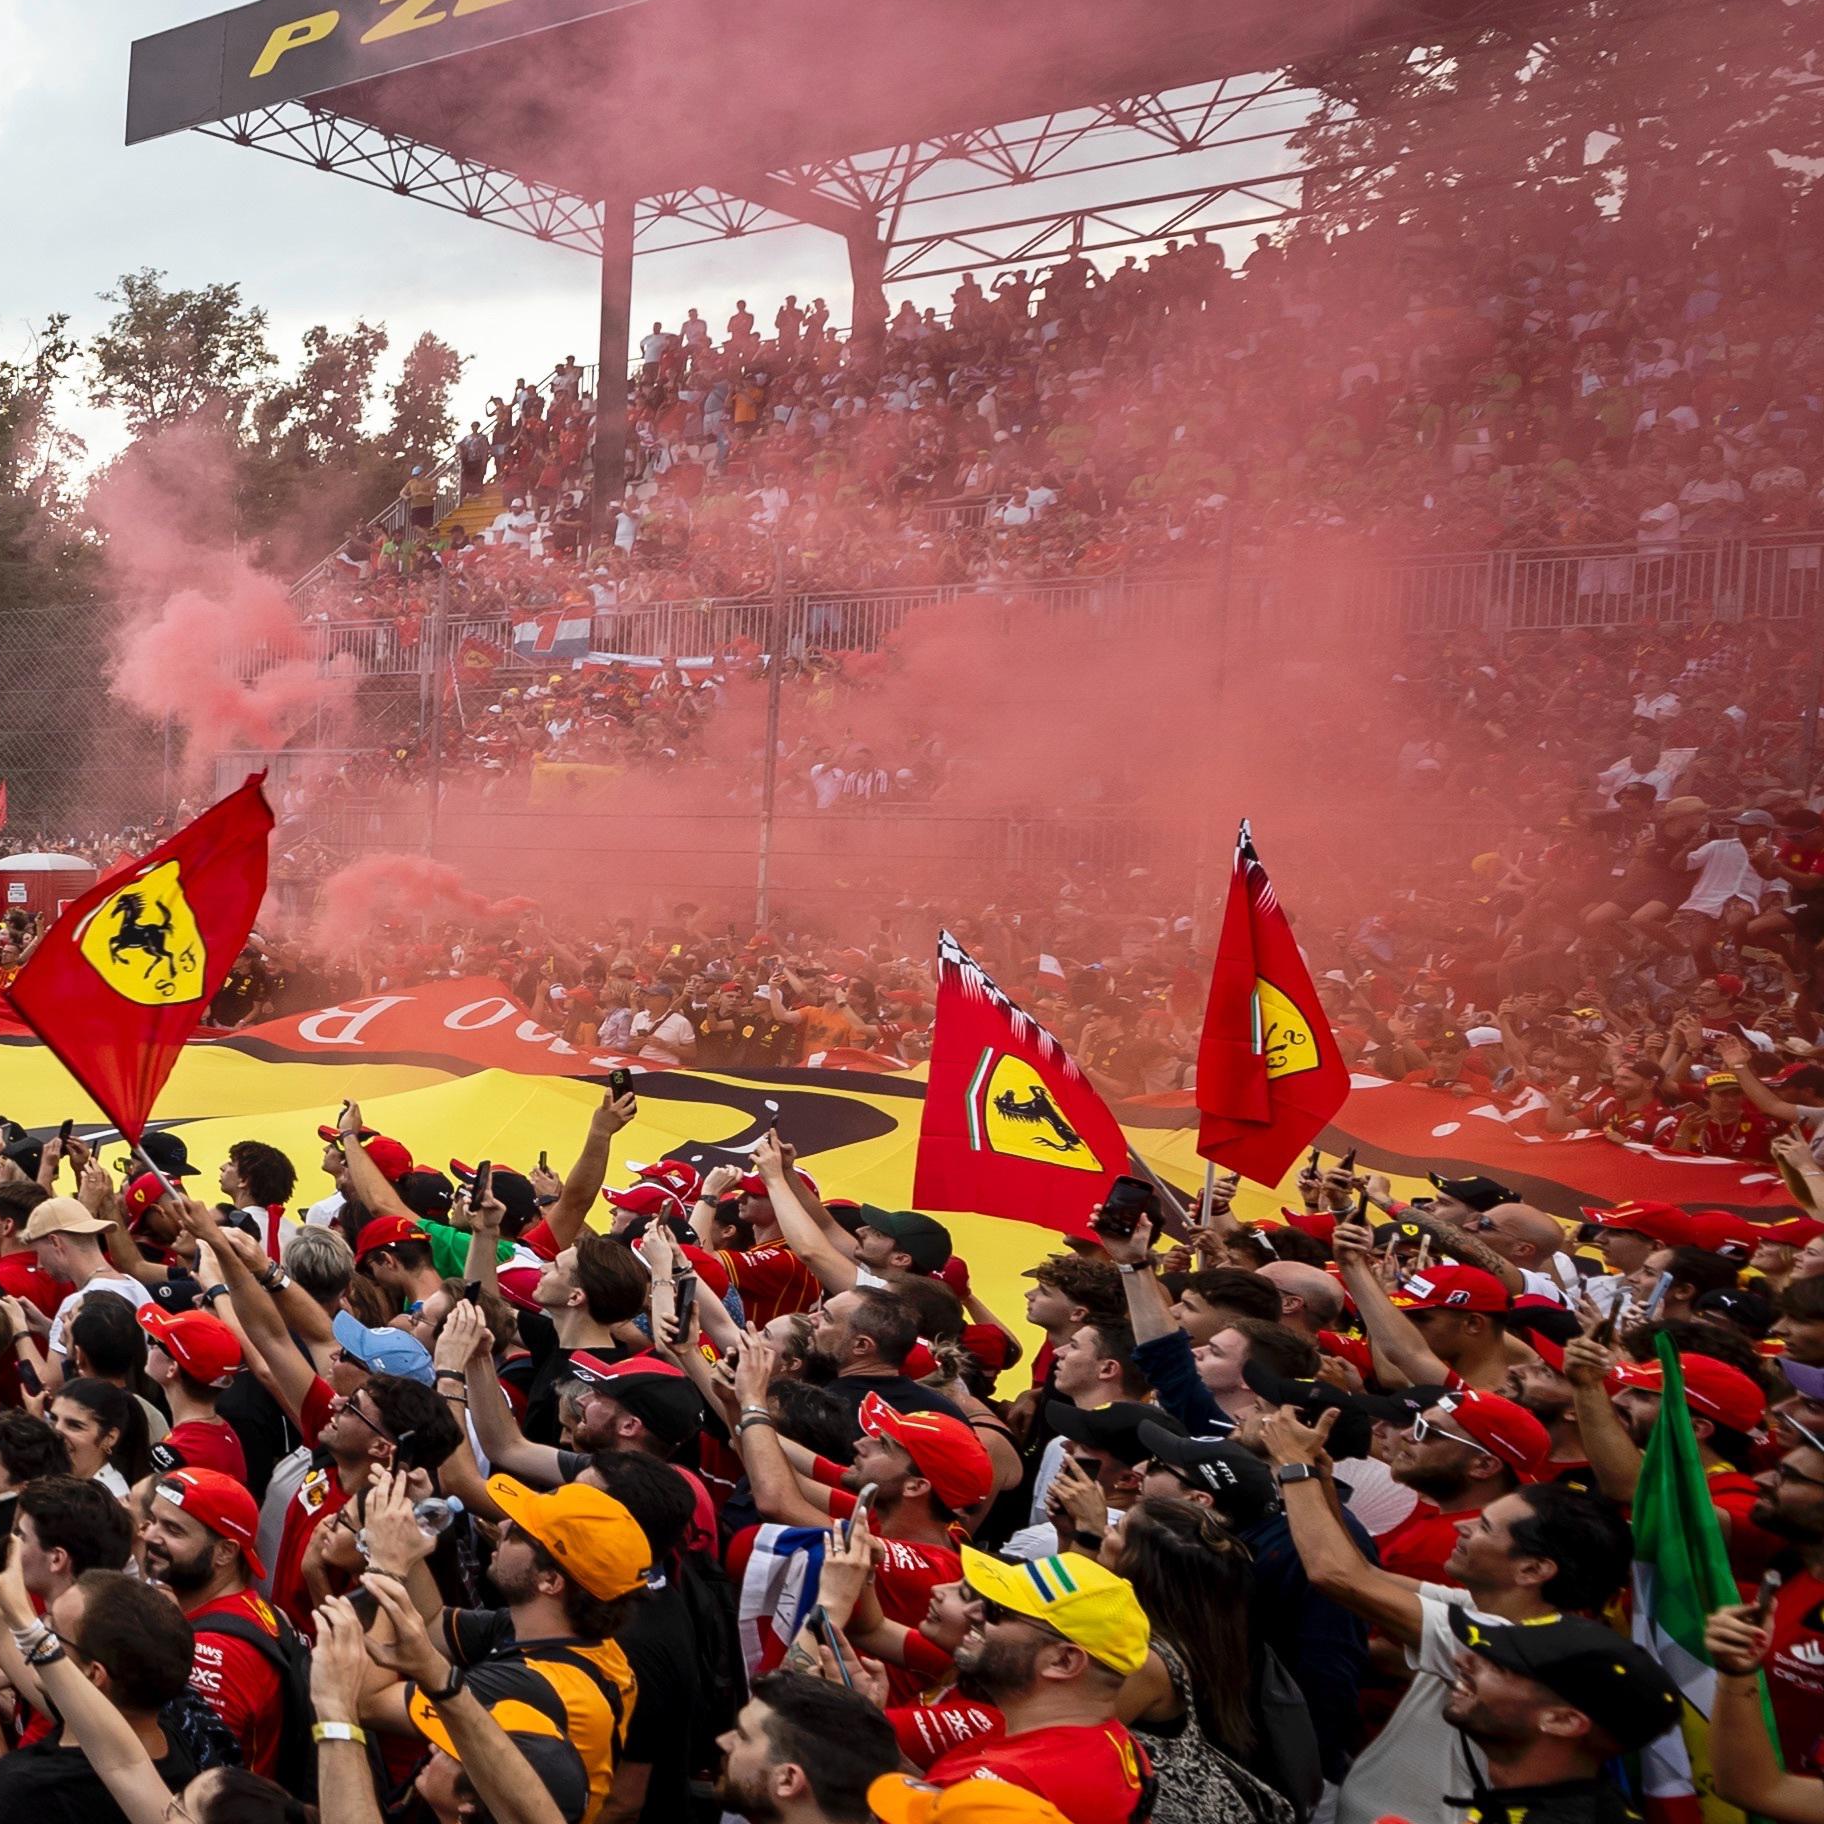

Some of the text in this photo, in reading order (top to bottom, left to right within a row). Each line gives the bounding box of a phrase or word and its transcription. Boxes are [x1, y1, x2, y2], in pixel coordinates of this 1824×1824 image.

[250, 10, 340, 78] P
[1218, 1462, 1239, 1484] FTX
[195, 1643, 223, 1660] aws
